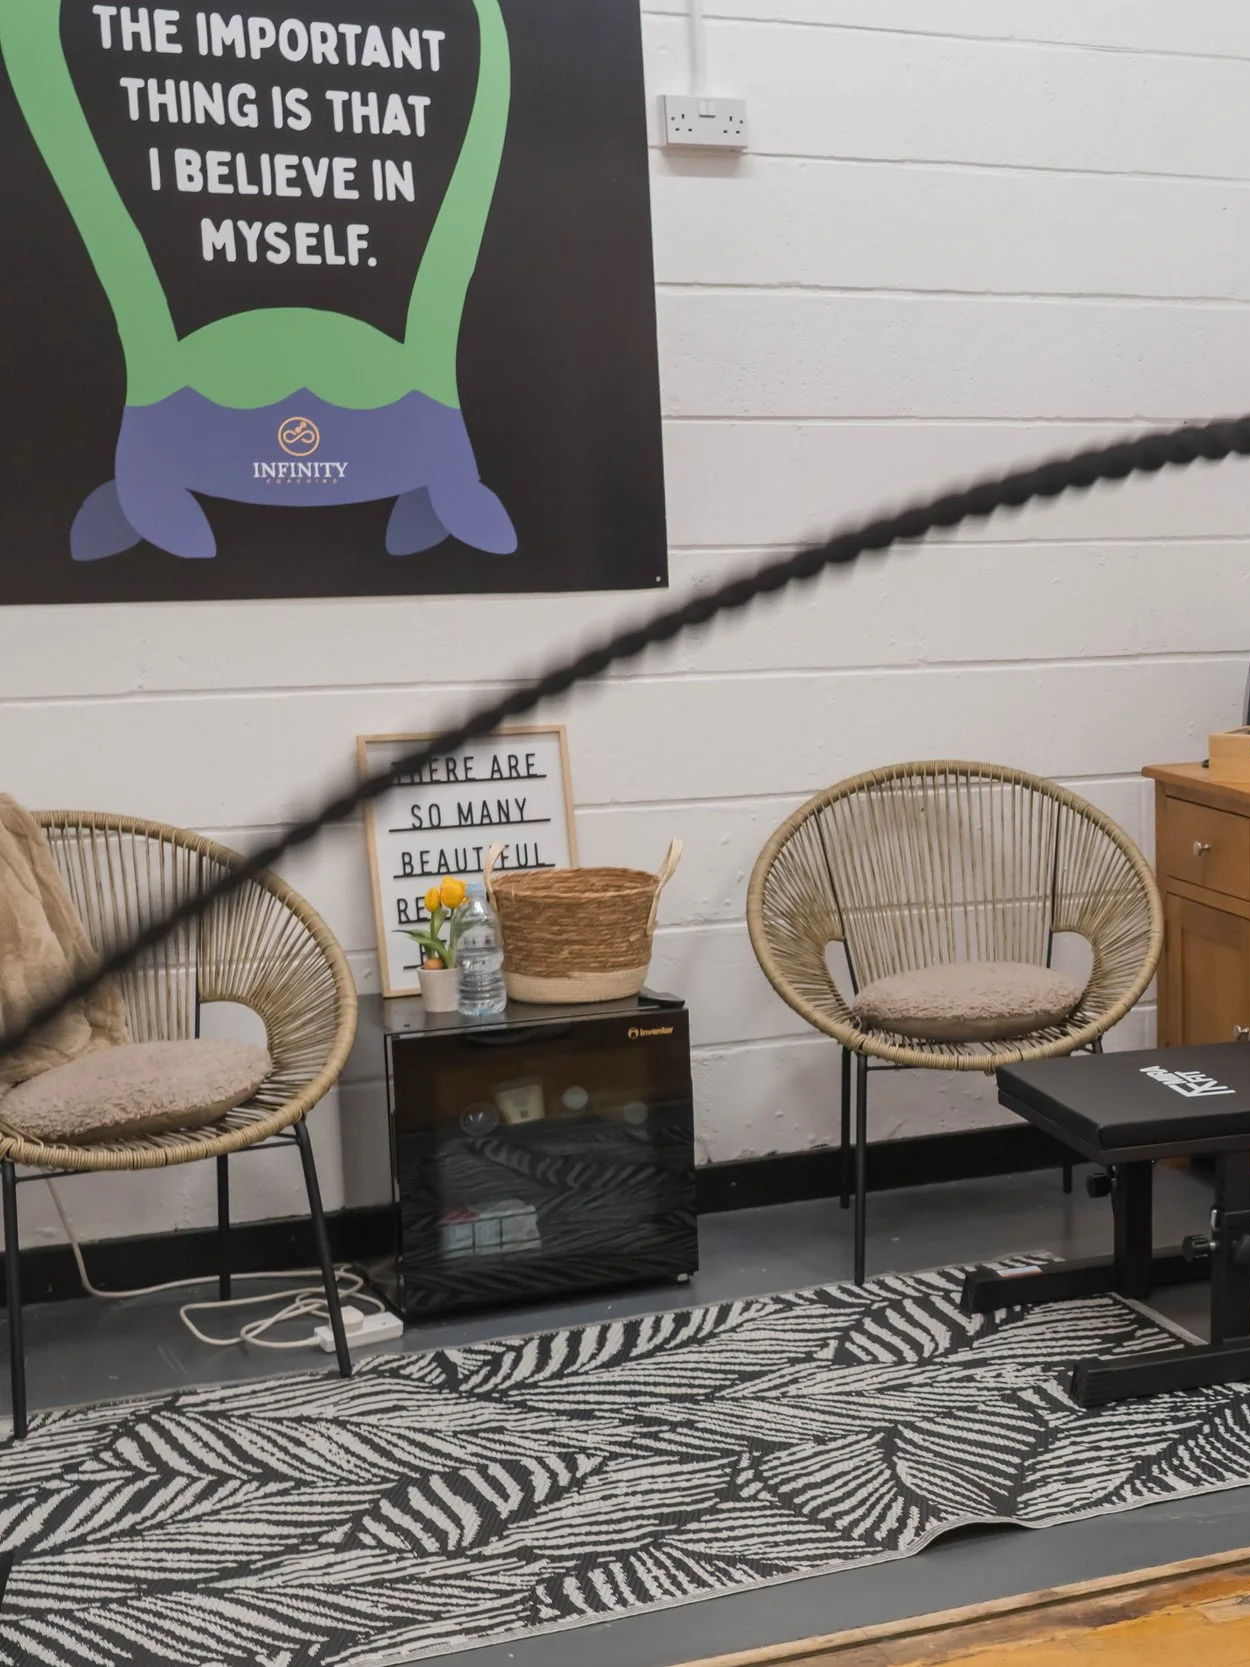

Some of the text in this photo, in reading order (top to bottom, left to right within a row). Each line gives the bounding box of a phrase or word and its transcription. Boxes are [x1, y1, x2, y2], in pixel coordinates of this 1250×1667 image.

[93, 5, 446, 71] THE IMPORTANT
[120, 78, 430, 137] THING IS THAT
[149, 148, 415, 202] I BELIEVE IN
[201, 218, 377, 267] MYSELF.
[253, 462, 348, 478] INFINITY
[490, 753, 538, 779] ARE
[410, 797, 526, 829] SO MANY
[401, 843, 546, 876] BEAUTFUL
